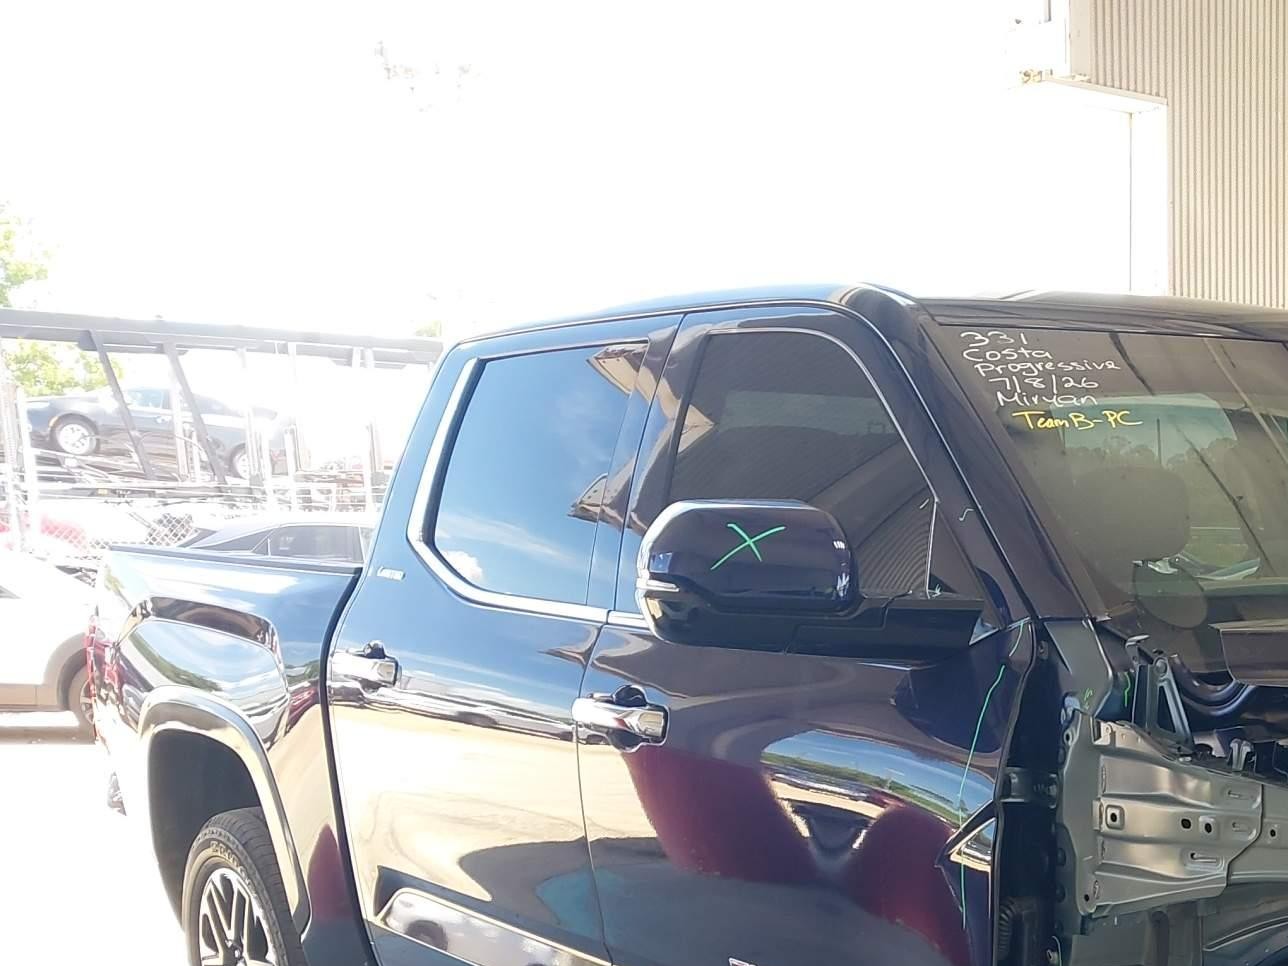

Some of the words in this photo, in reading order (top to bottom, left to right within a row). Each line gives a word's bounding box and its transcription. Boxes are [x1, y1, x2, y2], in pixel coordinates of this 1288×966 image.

[960, 331, 1028, 347] 331
[963, 347, 1053, 362] Costa
[974, 360, 1121, 377] Progressive
[988, 374, 1099, 394] 7/8/26
